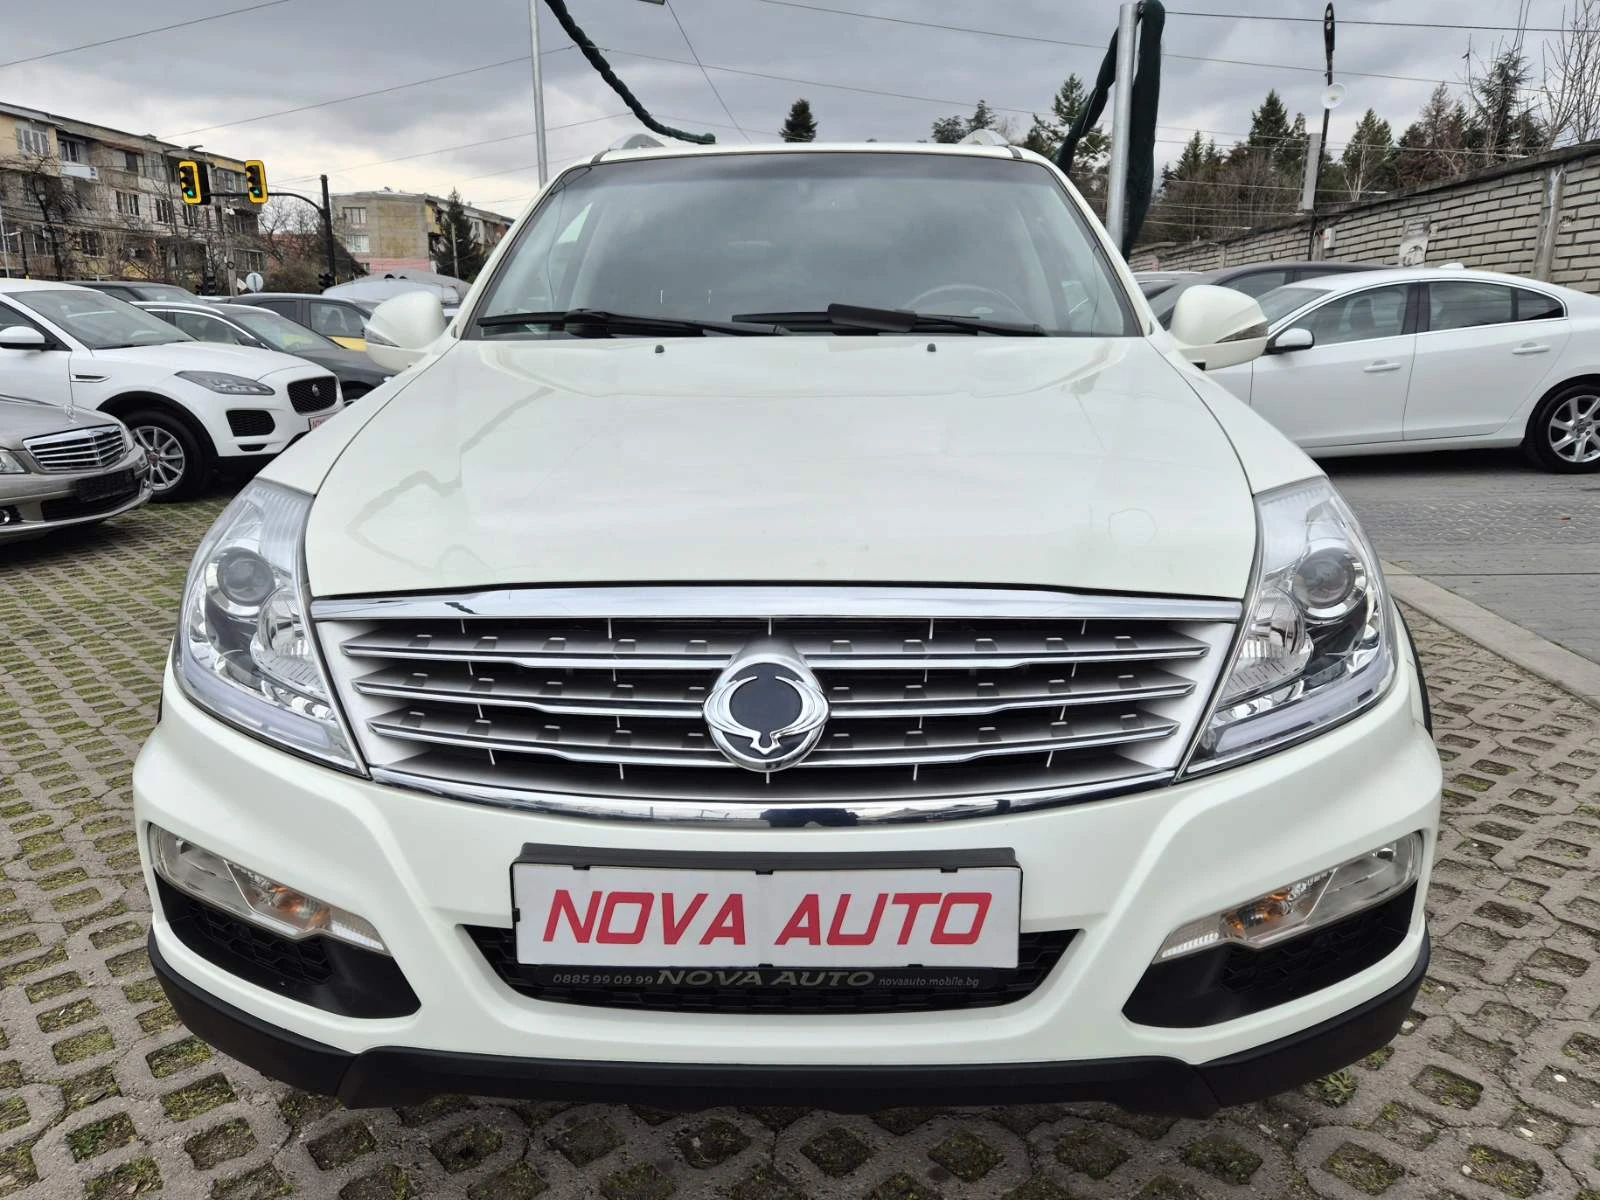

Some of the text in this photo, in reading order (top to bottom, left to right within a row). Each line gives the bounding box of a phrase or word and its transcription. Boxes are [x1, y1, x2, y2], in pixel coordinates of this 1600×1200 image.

[543, 889, 993, 946] NOVA AUTO
[553, 974, 590, 984] 0885
[593, 974, 610, 985] 99
[614, 975, 632, 985] 09
[635, 975, 653, 985] 99
[656, 970, 762, 986] NOVA
[771, 971, 875, 987] AUTO
